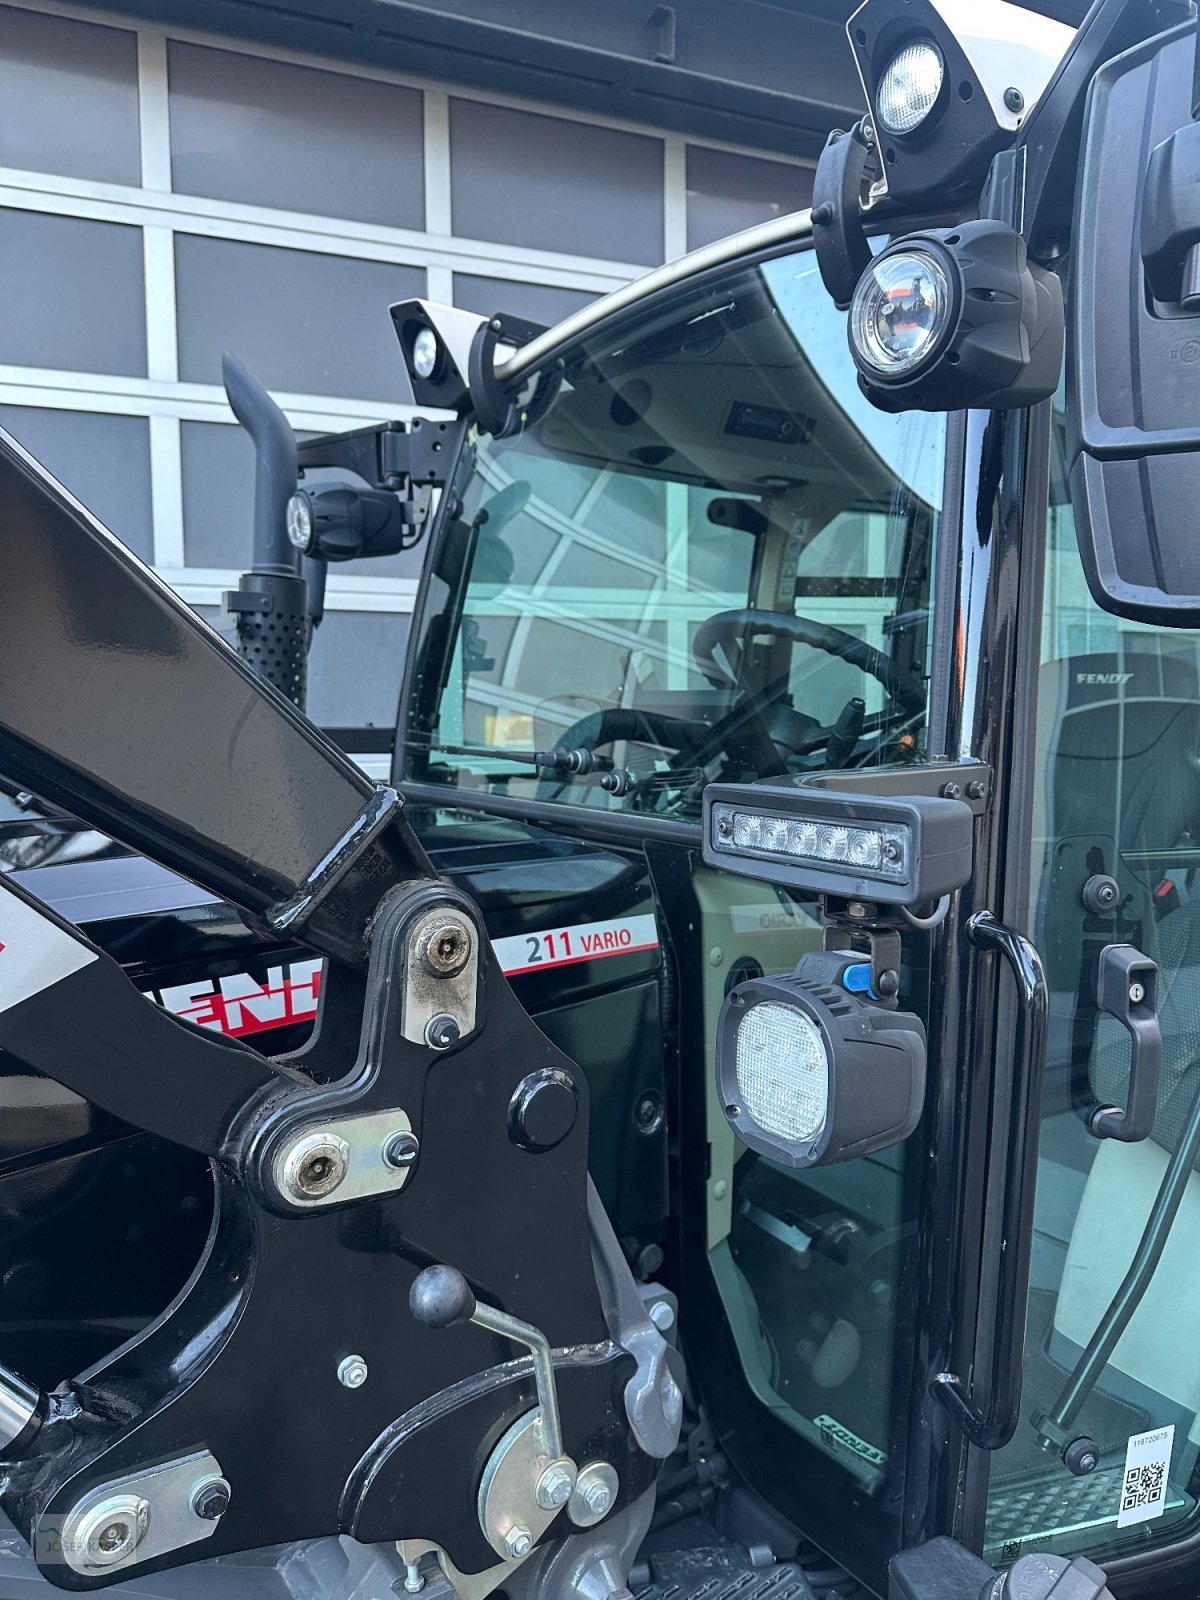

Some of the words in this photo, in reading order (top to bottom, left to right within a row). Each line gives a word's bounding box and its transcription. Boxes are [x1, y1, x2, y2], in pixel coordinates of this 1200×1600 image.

[1076, 673, 1135, 685] FENDT
[525, 930, 571, 963] 211
[580, 928, 632, 953] VARIO
